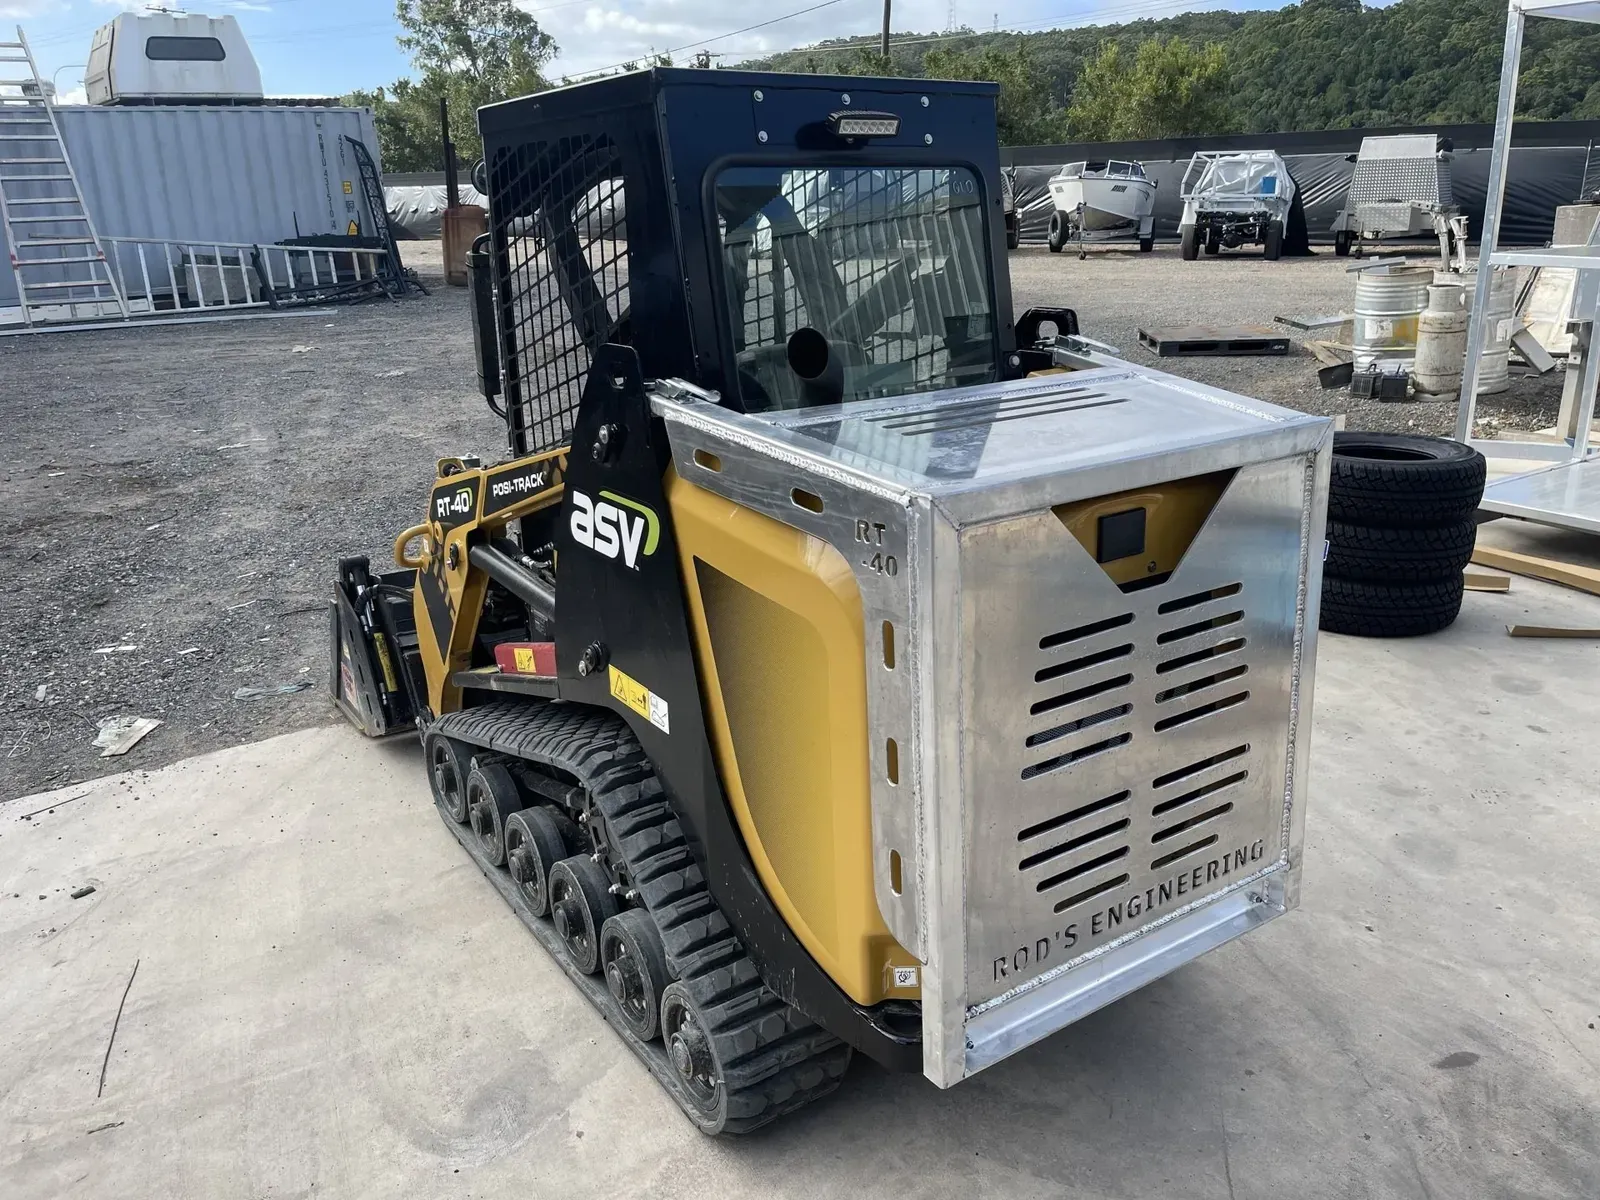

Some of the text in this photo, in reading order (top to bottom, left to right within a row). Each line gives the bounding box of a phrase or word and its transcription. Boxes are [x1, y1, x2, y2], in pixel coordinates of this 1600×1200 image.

[492, 471, 545, 498] POSI-TRACK
[436, 491, 470, 518] RT-40
[570, 490, 645, 569] asv
[854, 518, 886, 547] RT
[861, 551, 898, 578] -40
[992, 837, 1265, 984] ROD'S ENGINEERING
